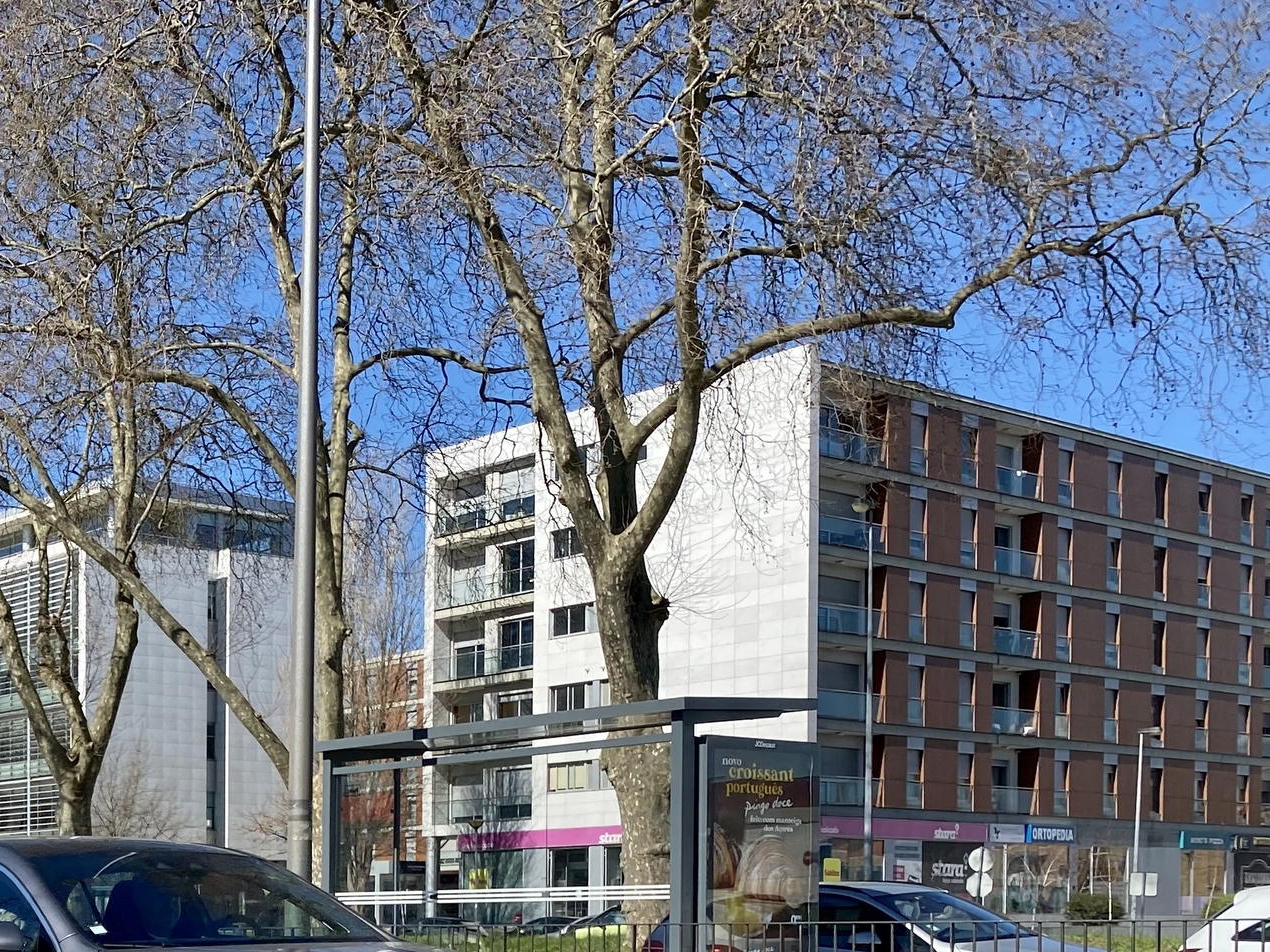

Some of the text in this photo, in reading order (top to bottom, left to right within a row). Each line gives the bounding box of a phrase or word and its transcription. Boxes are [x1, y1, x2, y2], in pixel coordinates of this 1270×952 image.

[722, 758, 742, 766] novo
[728, 763, 794, 782] croissant
[726, 782, 784, 799] português
[772, 796, 794, 809] doce
[1032, 828, 1074, 841] ORTOPEDIA
